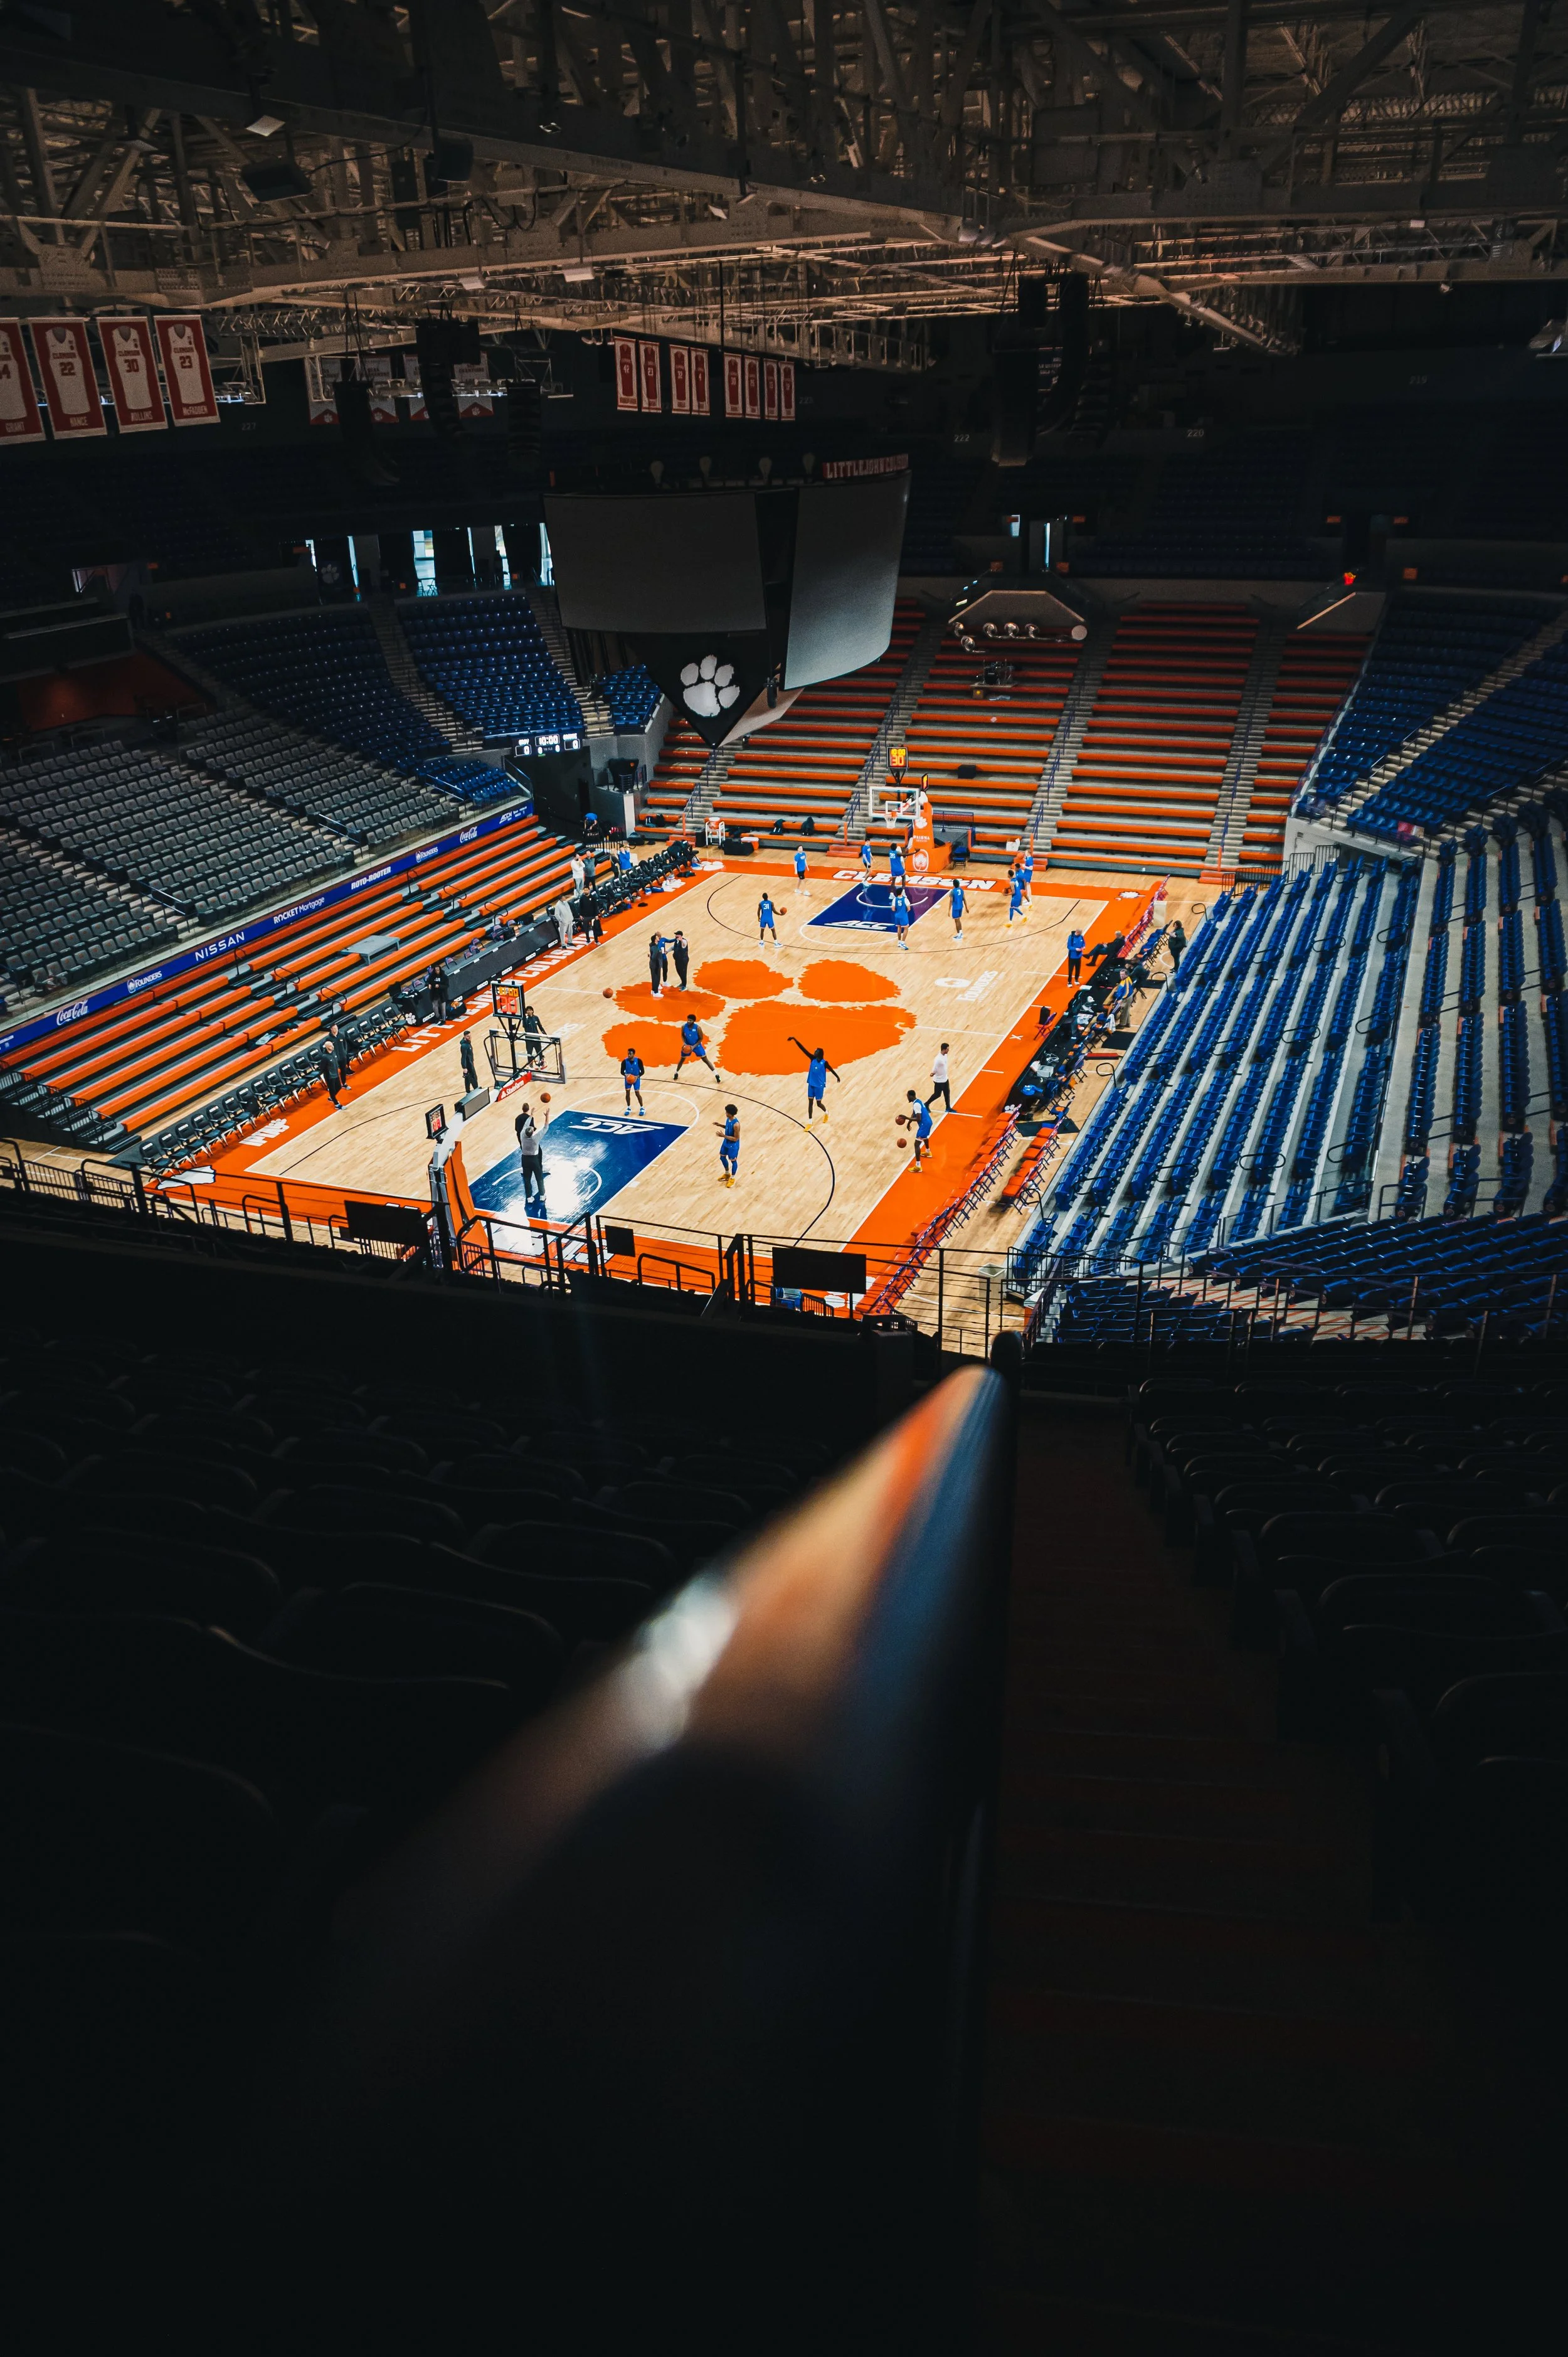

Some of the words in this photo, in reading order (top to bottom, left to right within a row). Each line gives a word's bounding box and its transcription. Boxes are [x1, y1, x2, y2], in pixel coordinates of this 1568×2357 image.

[125, 359, 139, 373] 30
[179, 356, 193, 368] 23
[60, 362, 75, 376] 22
[70, 417, 88, 427] NANCE
[131, 411, 153, 422] ROLLINS
[953, 434, 970, 442] 222
[1187, 429, 1204, 437] 220
[827, 457, 884, 479] LITTLEJOHN
[539, 735, 558, 745] 10:00
[573, 740, 578, 749] 0
[524, 746, 529, 755] 0
[892, 755, 904, 765] 30
[421, 847, 438, 858] FOUNDERS
[351, 866, 391, 890] ROTO-ROOTER
[273, 907, 299, 924] ROCKET
[299, 897, 325, 913] Mortgage
[824, 920, 896, 930] ACC
[195, 932, 245, 961] NISSAN
[135, 971, 162, 987] FOUNDERS
[568, 1116, 665, 1134] ACC
